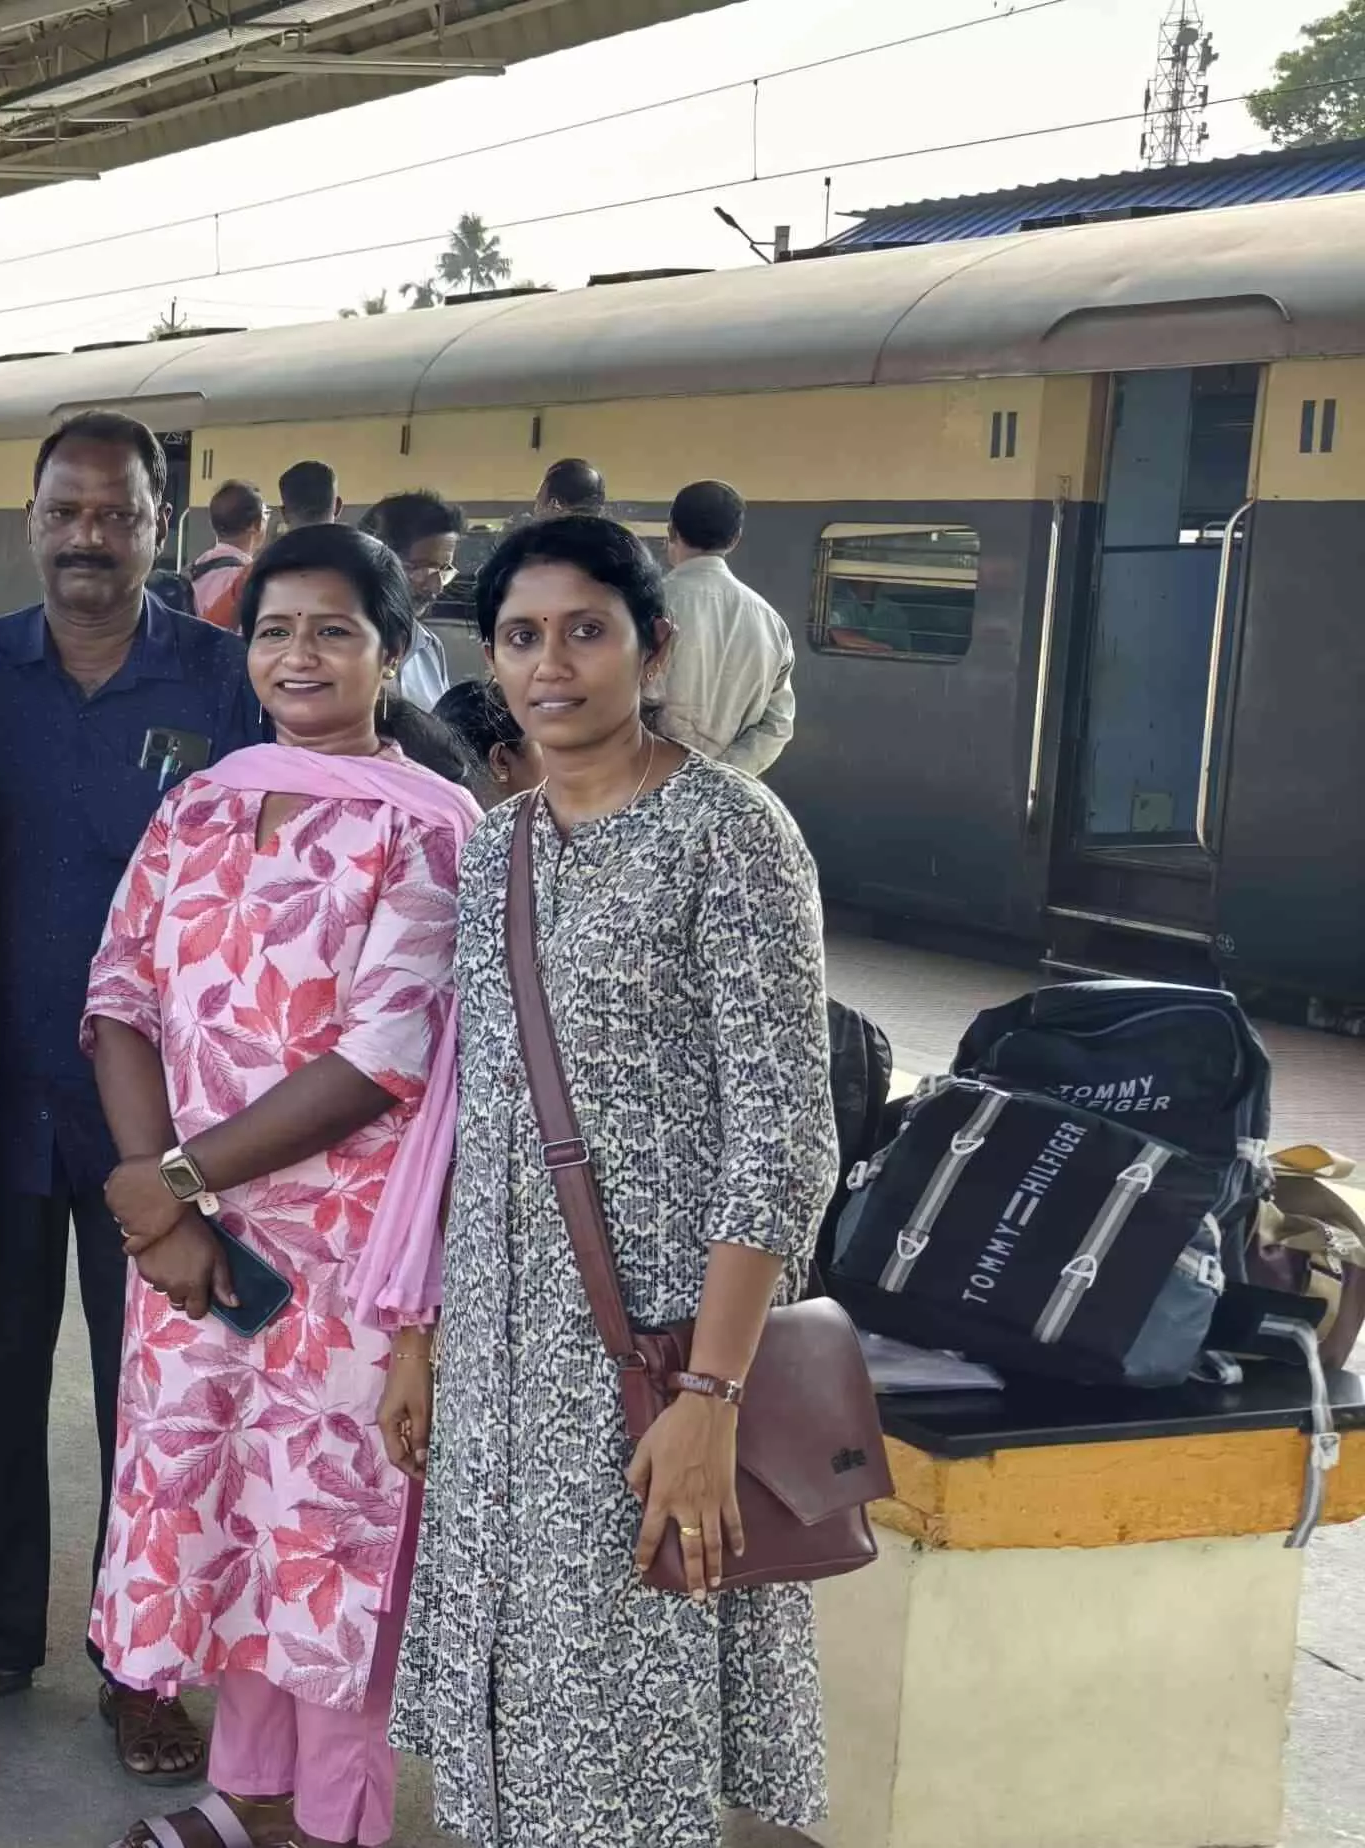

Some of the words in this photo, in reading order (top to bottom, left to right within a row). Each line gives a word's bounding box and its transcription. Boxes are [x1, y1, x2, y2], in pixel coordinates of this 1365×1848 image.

[1059, 1075, 1153, 1099] TOMMY
[961, 1222, 1021, 1303] TOMMY
[1020, 1121, 1088, 1195] HILFIGER
